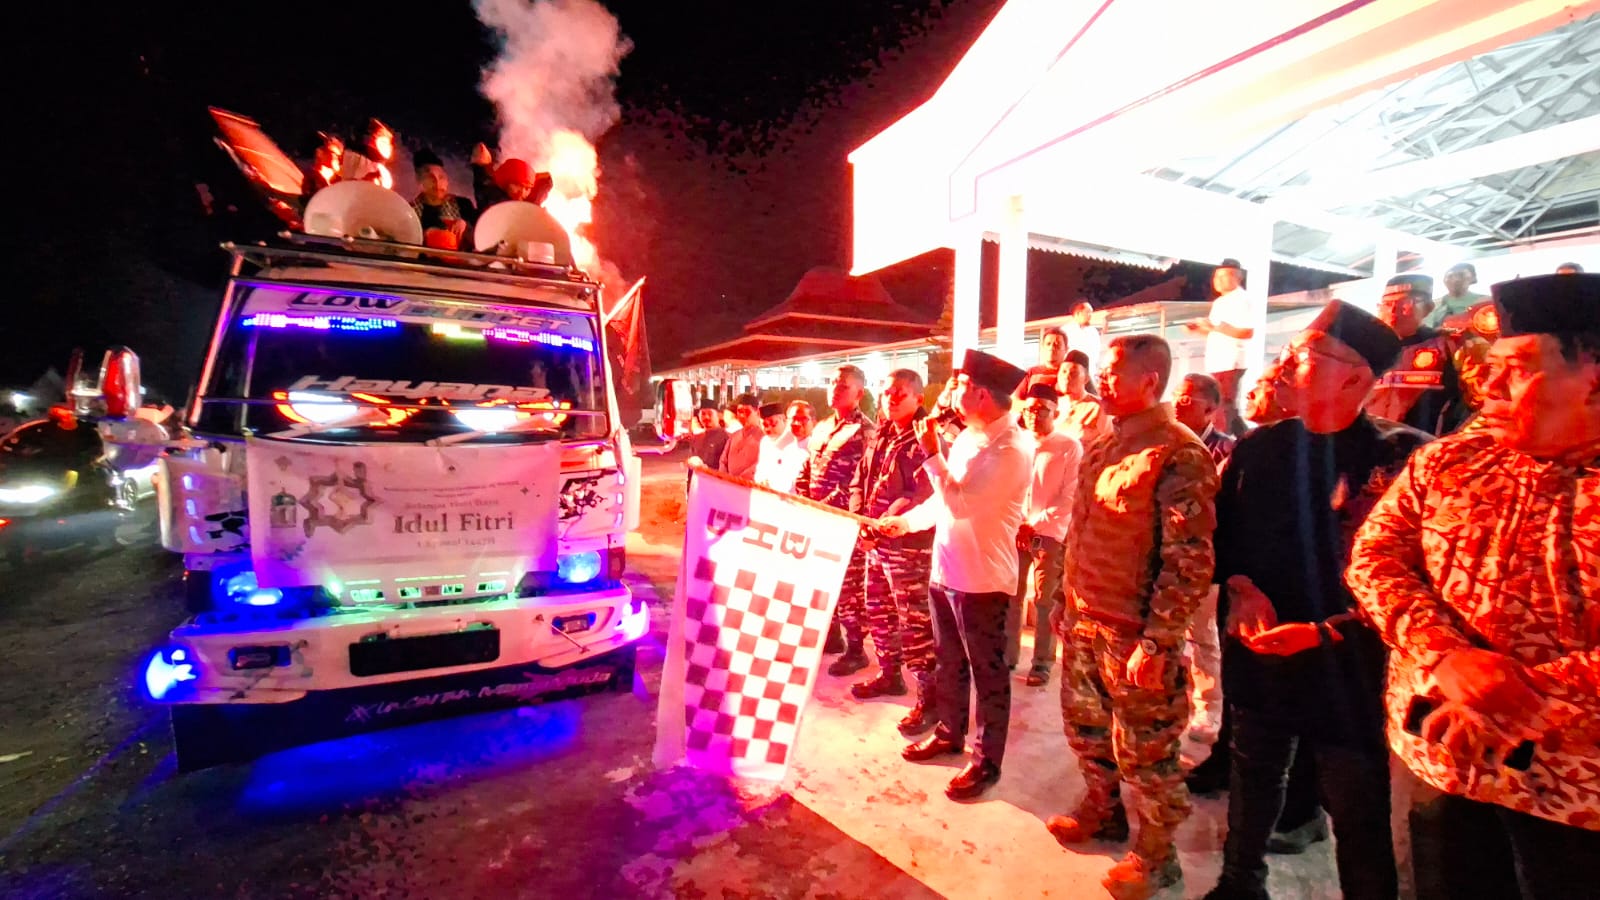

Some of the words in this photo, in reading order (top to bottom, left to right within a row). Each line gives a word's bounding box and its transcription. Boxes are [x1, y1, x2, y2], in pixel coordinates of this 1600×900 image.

[290, 291, 400, 311] LOW
[393, 512, 448, 534] Idul
[459, 511, 514, 531] Fitri
